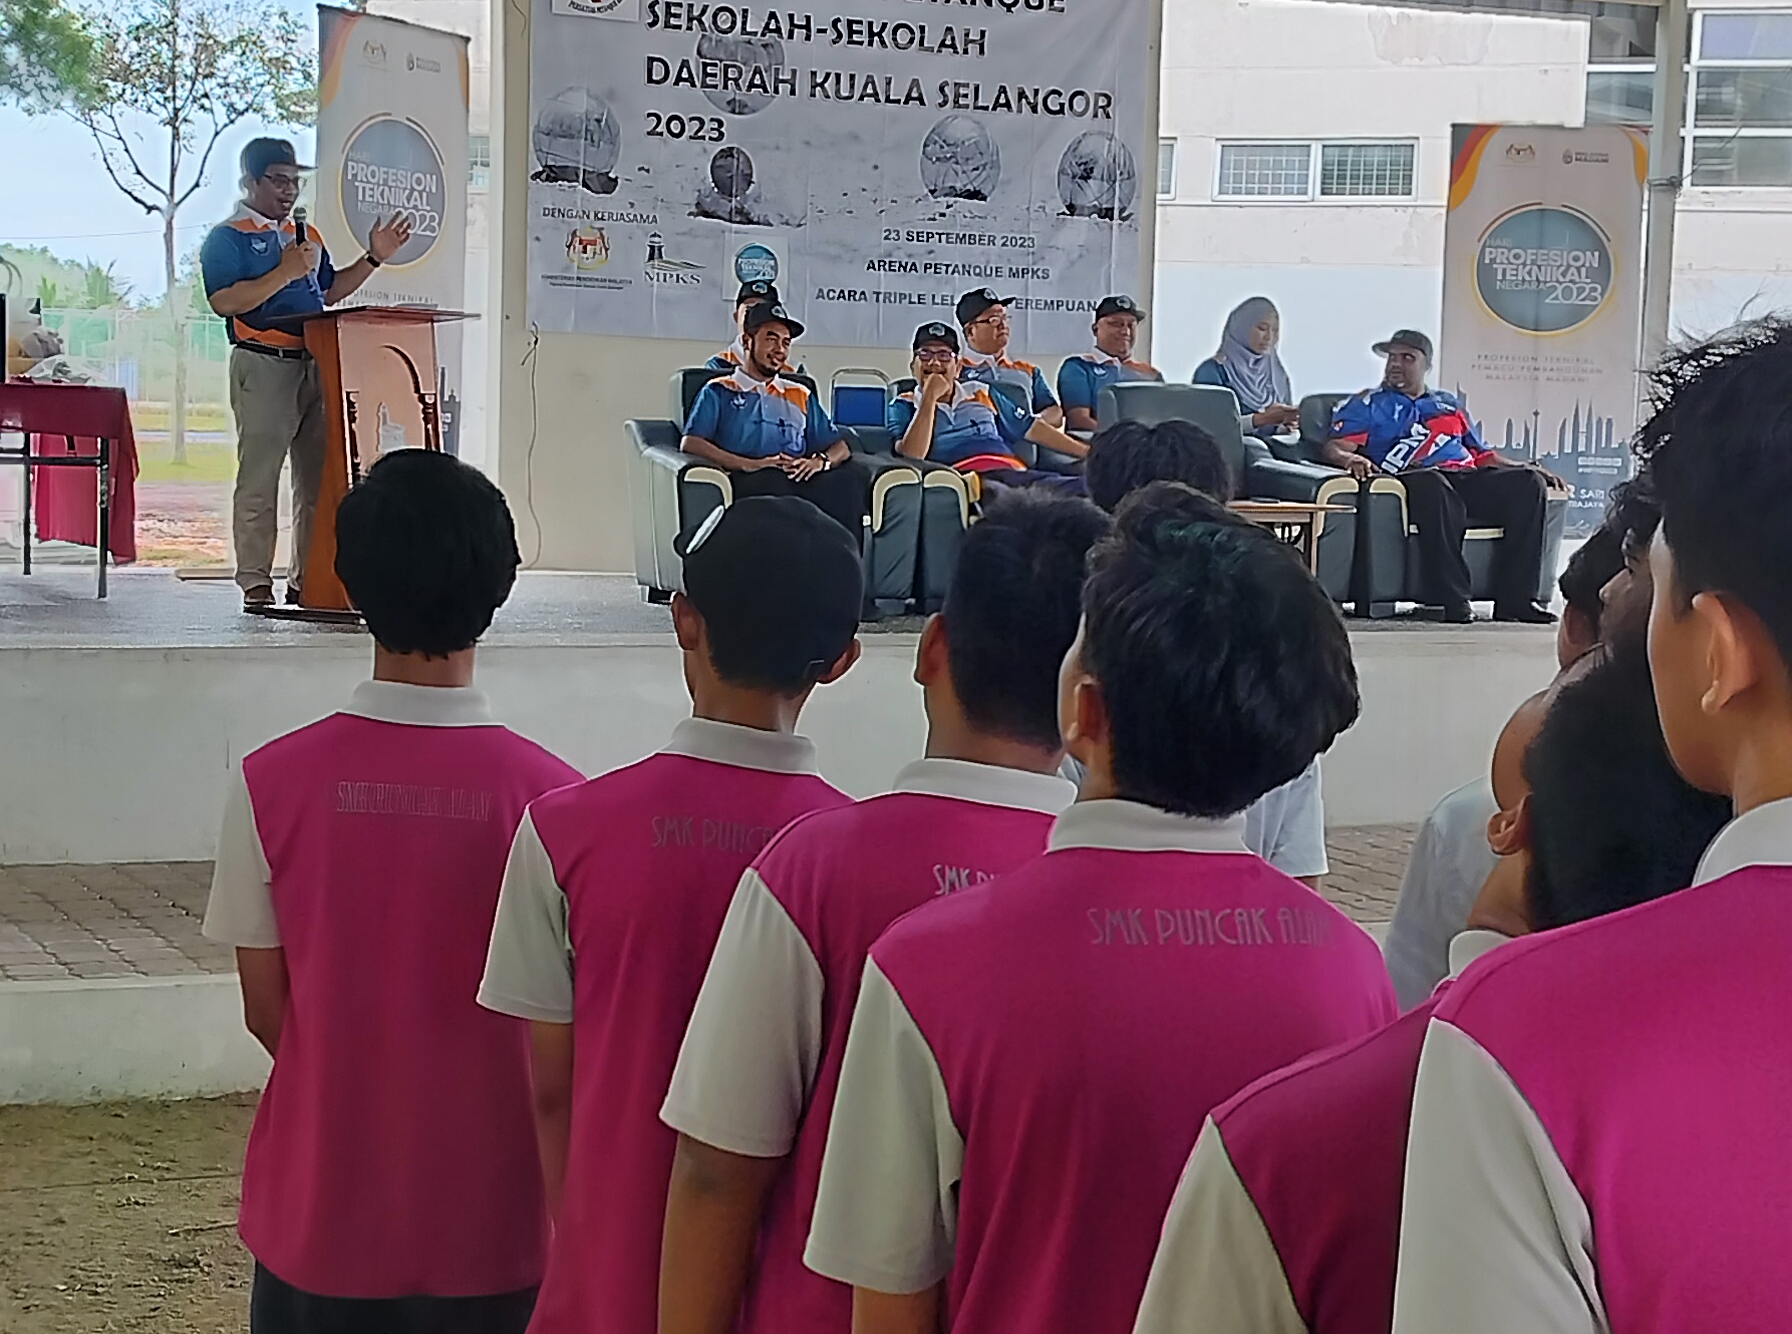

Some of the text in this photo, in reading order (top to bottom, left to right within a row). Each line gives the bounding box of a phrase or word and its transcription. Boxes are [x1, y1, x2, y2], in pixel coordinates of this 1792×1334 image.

[646, 0, 987, 56] SEKOLAH-SEKOLAH
[646, 55, 1113, 119] DAERAH KUALA SELANGOR
[646, 112, 725, 142] 2023
[347, 161, 437, 193] PROFESION
[354, 181, 431, 210] TEKNIKAL
[542, 206, 658, 225] DENGAN KERJASAMA
[882, 228, 1036, 248] 23 SEPTEMBER 2023
[866, 259, 1050, 280] ARENA PETANQUE MPKS
[1484, 247, 1600, 267] PROFESION
[643, 270, 701, 285] MPKS
[1493, 264, 1591, 282] TEKNIKAL
[815, 288, 1097, 312] ACARA TRIPLE LEL EREMPUAN
[1496, 280, 1602, 305] NEGARA 2023
[651, 816, 774, 855] SMK PUNCA
[932, 863, 971, 895] SMK
[1086, 907, 1150, 946] SMK
[1154, 908, 1275, 947] PUNCAK
